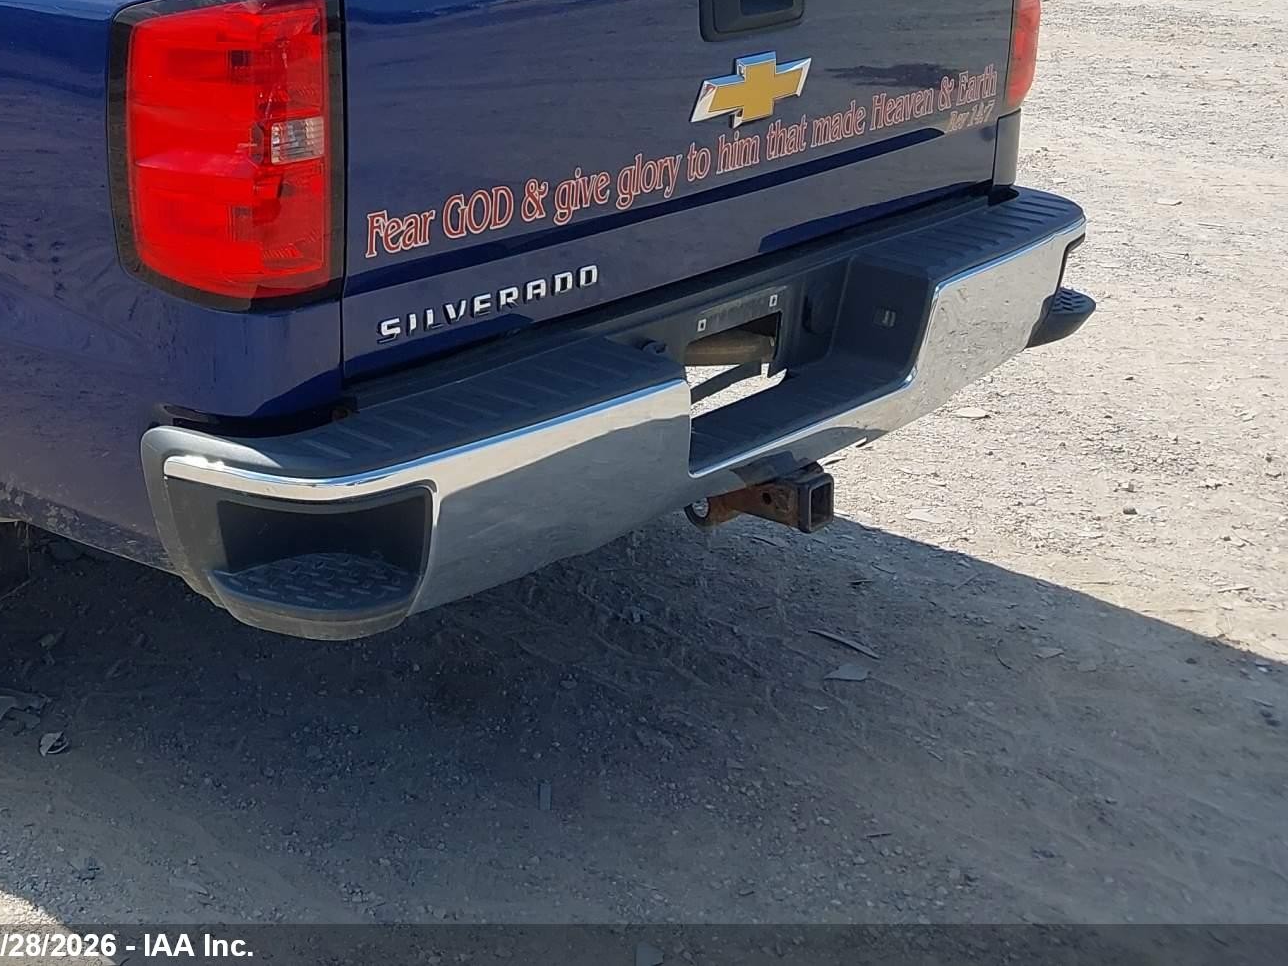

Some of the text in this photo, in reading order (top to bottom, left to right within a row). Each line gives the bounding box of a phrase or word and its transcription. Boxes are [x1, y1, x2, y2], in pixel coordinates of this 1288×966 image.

[365, 64, 997, 258] Fear GOD & give glory to him that made Heaven & Earth
[947, 110, 970, 133] Rev
[377, 265, 599, 344] SILVERADO
